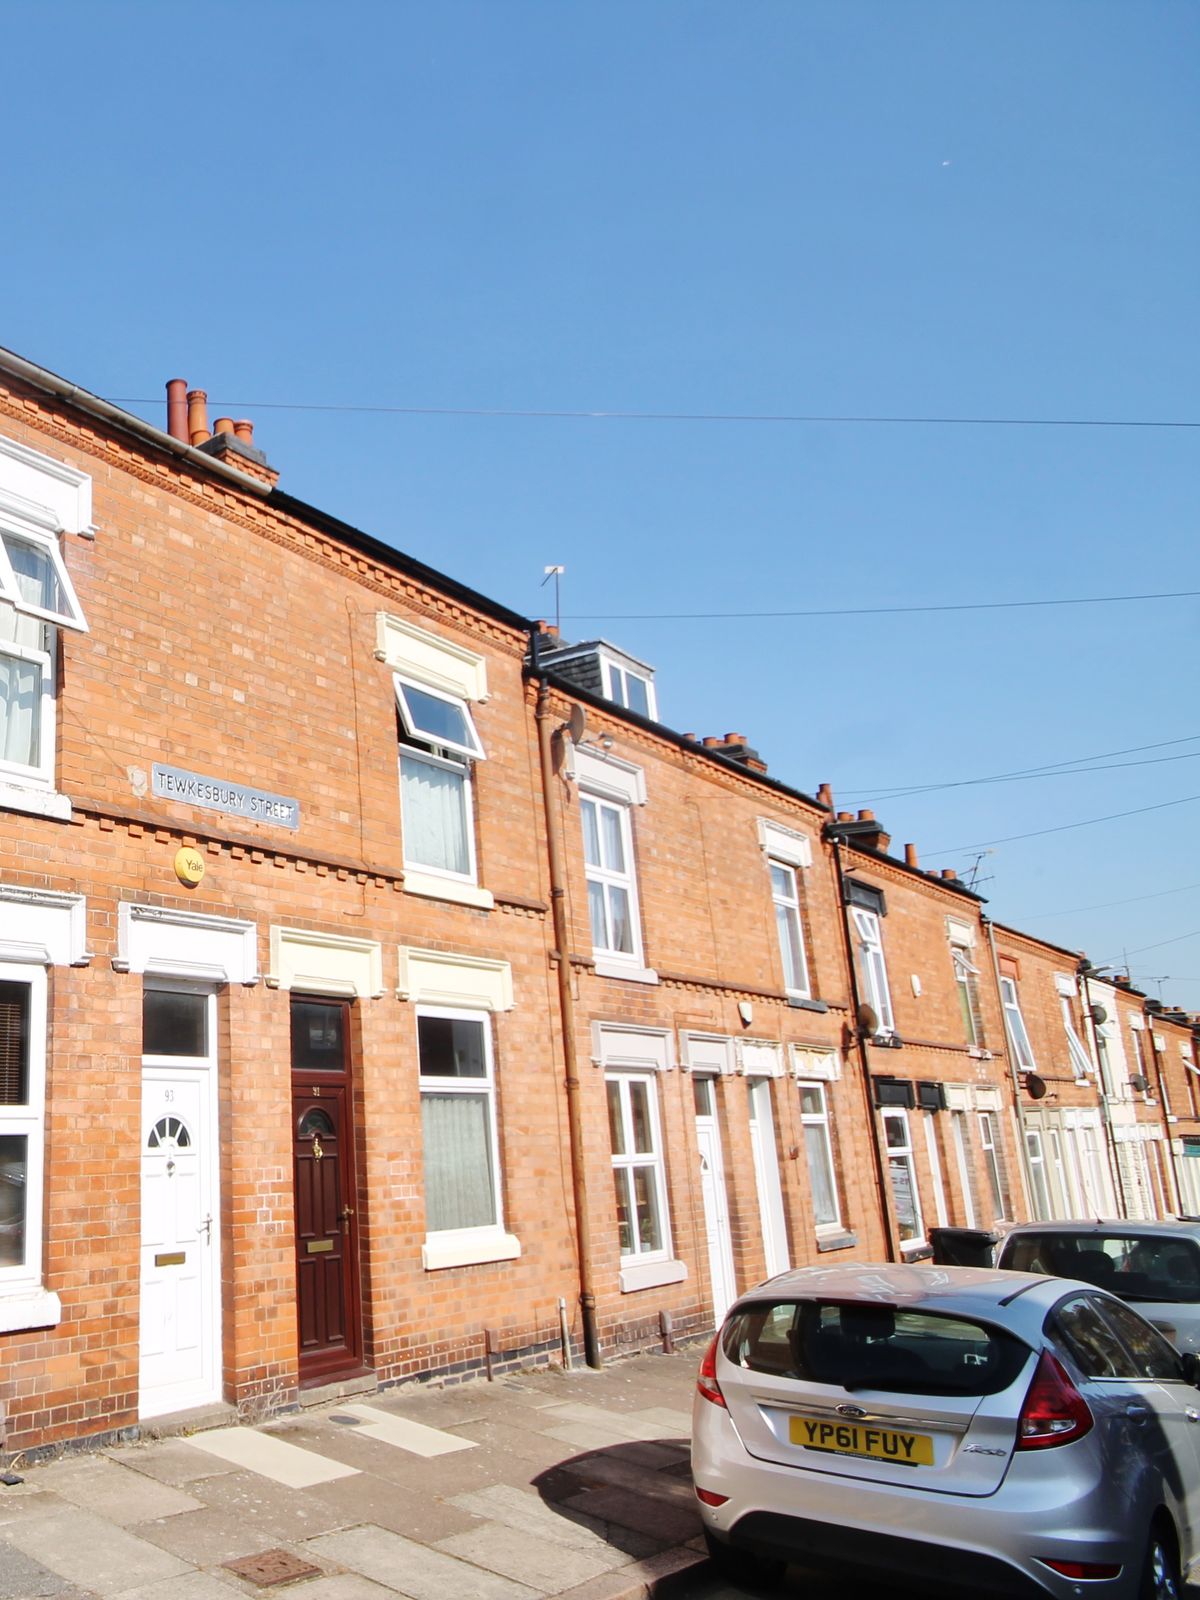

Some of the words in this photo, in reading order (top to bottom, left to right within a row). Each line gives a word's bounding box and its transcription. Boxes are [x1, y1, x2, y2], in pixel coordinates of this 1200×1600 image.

[158, 772, 244, 808] TEWKESBURY
[251, 796, 293, 820] STREET
[186, 858, 203, 873] Yale
[165, 1089, 174, 1102] 93
[804, 1421, 857, 1449] YP61
[865, 1430, 915, 1457] FUY
